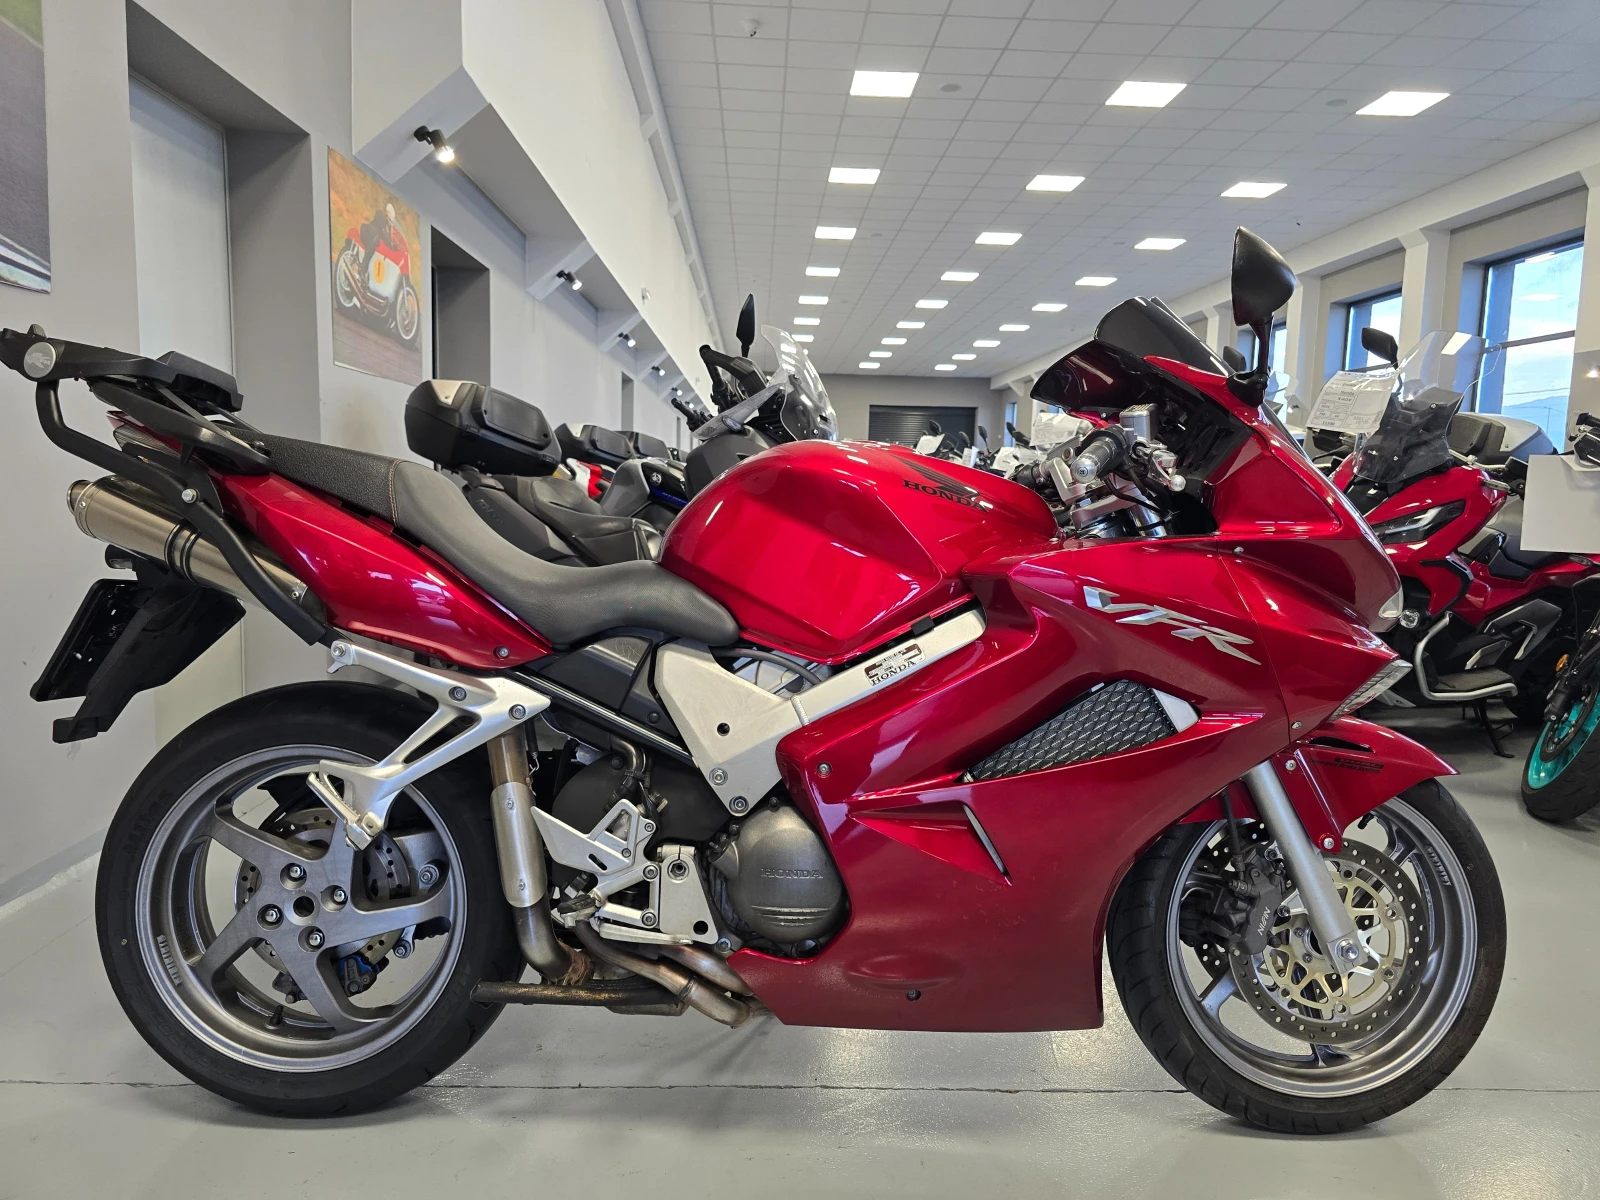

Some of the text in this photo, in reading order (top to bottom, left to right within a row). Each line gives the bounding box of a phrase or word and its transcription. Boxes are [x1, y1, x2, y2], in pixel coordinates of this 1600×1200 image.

[903, 479, 989, 513] HONDA
[1083, 586, 1262, 666] VFR
[871, 660, 917, 687] HONDA
[761, 868, 824, 879] HONDA
